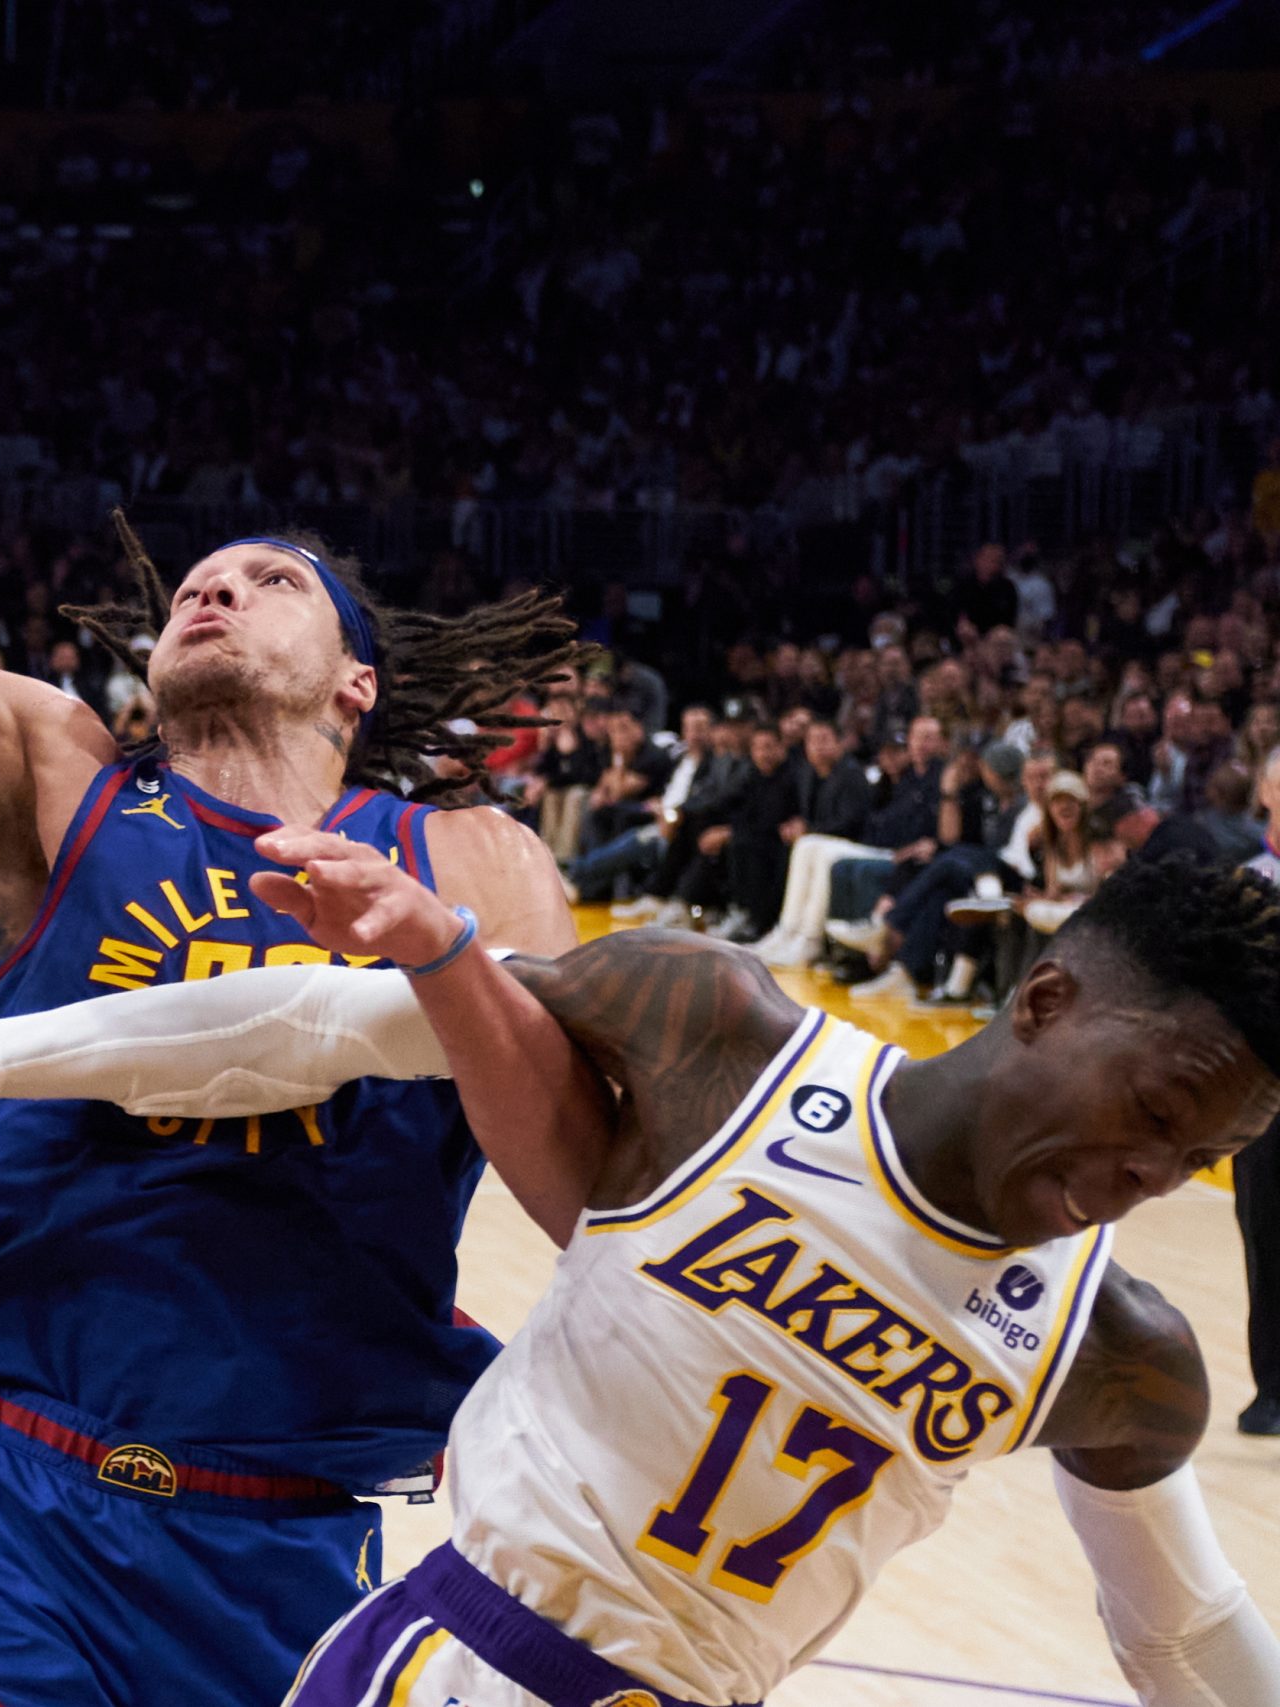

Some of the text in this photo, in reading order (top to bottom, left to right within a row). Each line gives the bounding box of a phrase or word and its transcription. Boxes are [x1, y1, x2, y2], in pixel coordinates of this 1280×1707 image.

[88, 867, 251, 991] MILE
[797, 1091, 843, 1129] 6
[638, 1184, 1016, 1464] LAKERS
[964, 1287, 1041, 1352] bibigo
[634, 1370, 900, 1605] 17
